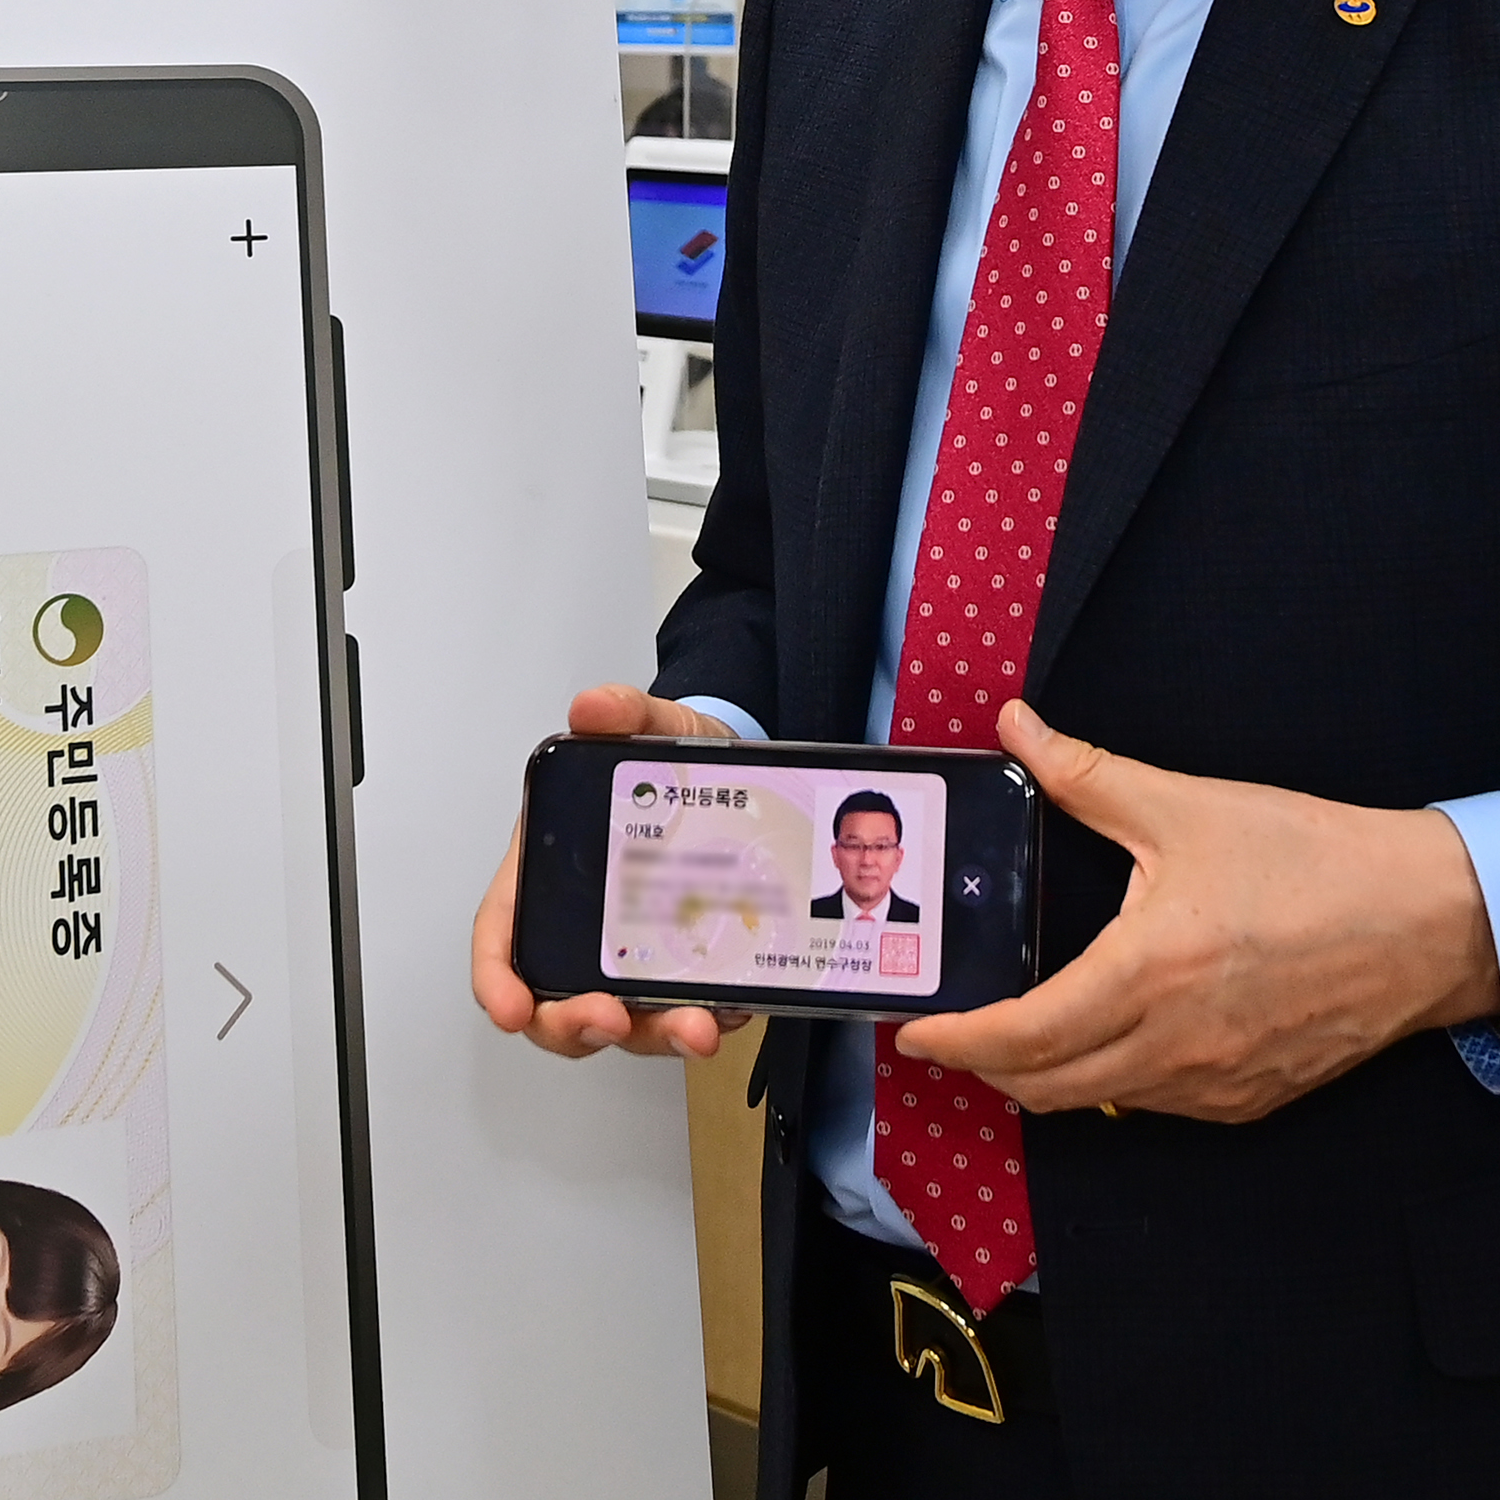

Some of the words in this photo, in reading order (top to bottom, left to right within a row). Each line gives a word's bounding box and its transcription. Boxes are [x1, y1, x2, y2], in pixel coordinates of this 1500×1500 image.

[663, 785, 749, 810] 주민등록증
[45, 682, 102, 962] 주민등록증
[625, 822, 664, 840] 이재호
